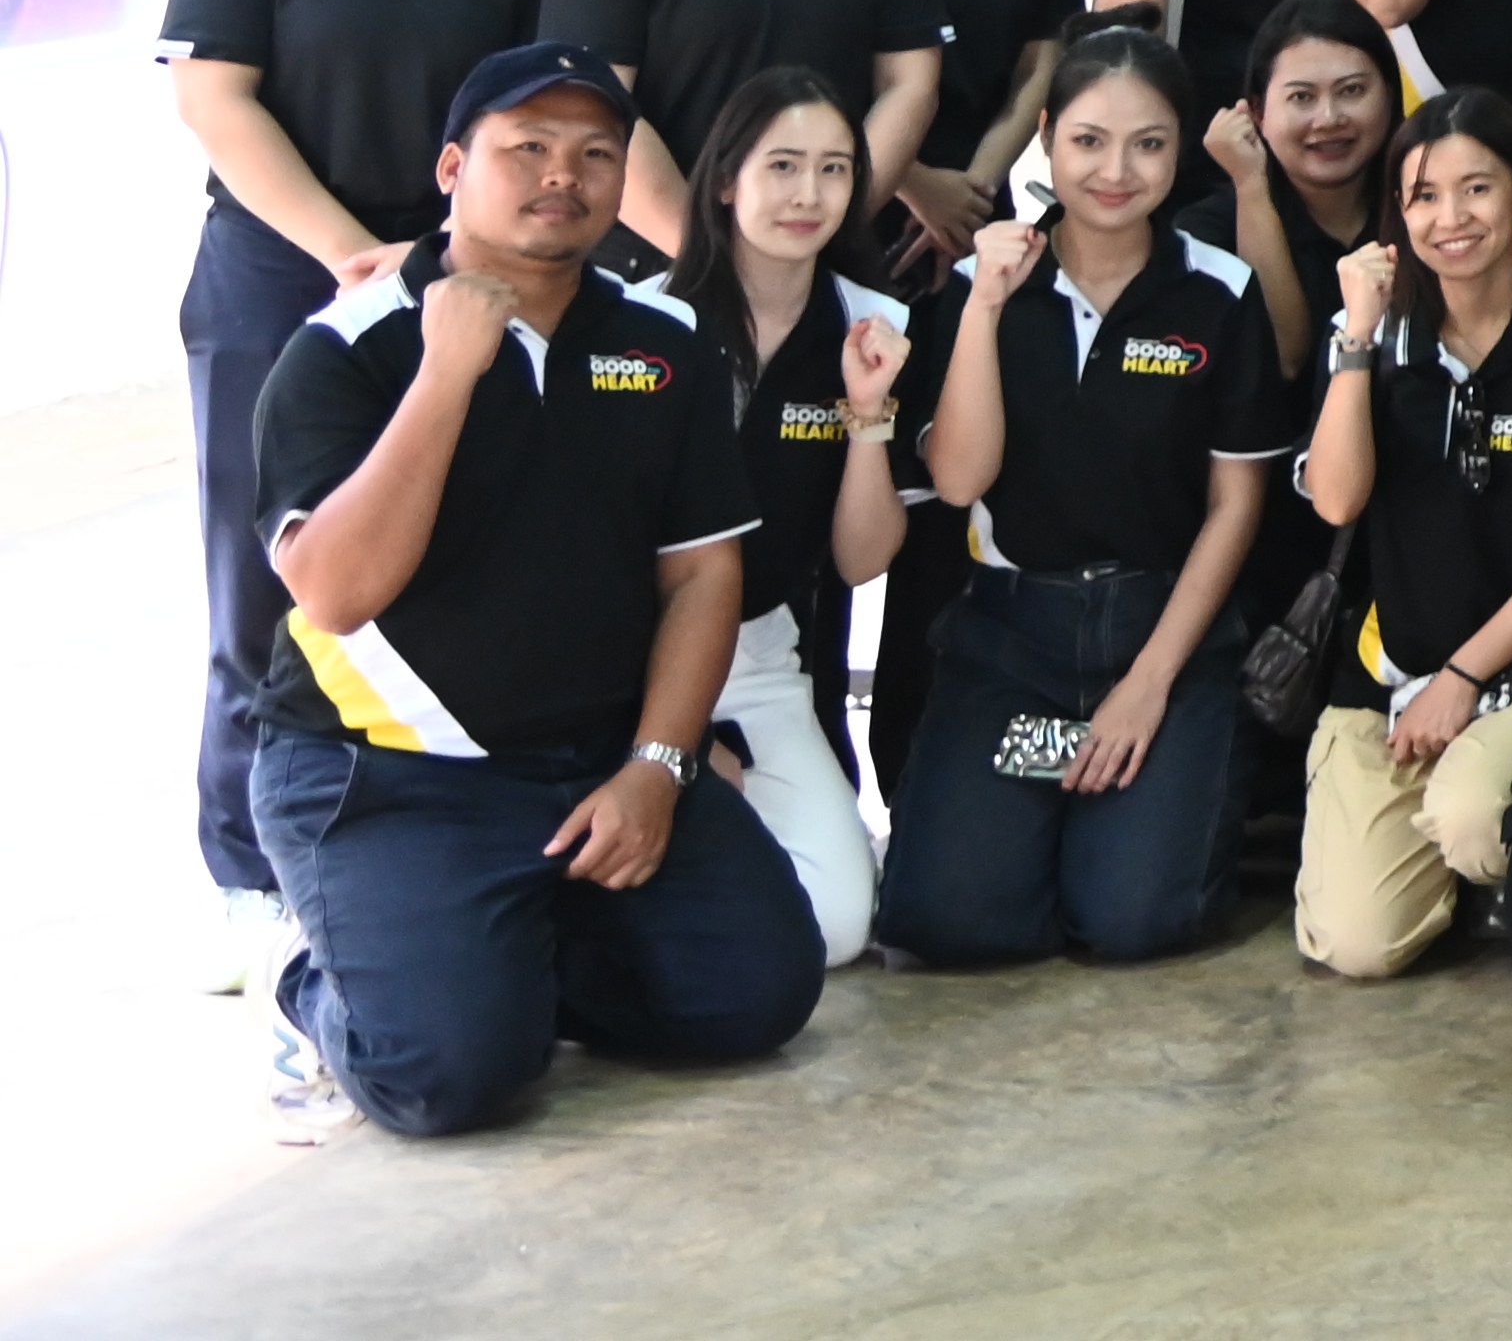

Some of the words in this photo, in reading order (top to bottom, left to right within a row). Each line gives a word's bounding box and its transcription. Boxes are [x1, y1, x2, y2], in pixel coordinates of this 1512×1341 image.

[1123, 341, 1183, 361] GOOD
[590, 358, 647, 376] GOOD
[1121, 356, 1190, 376] HEART
[591, 374, 658, 391] HEART
